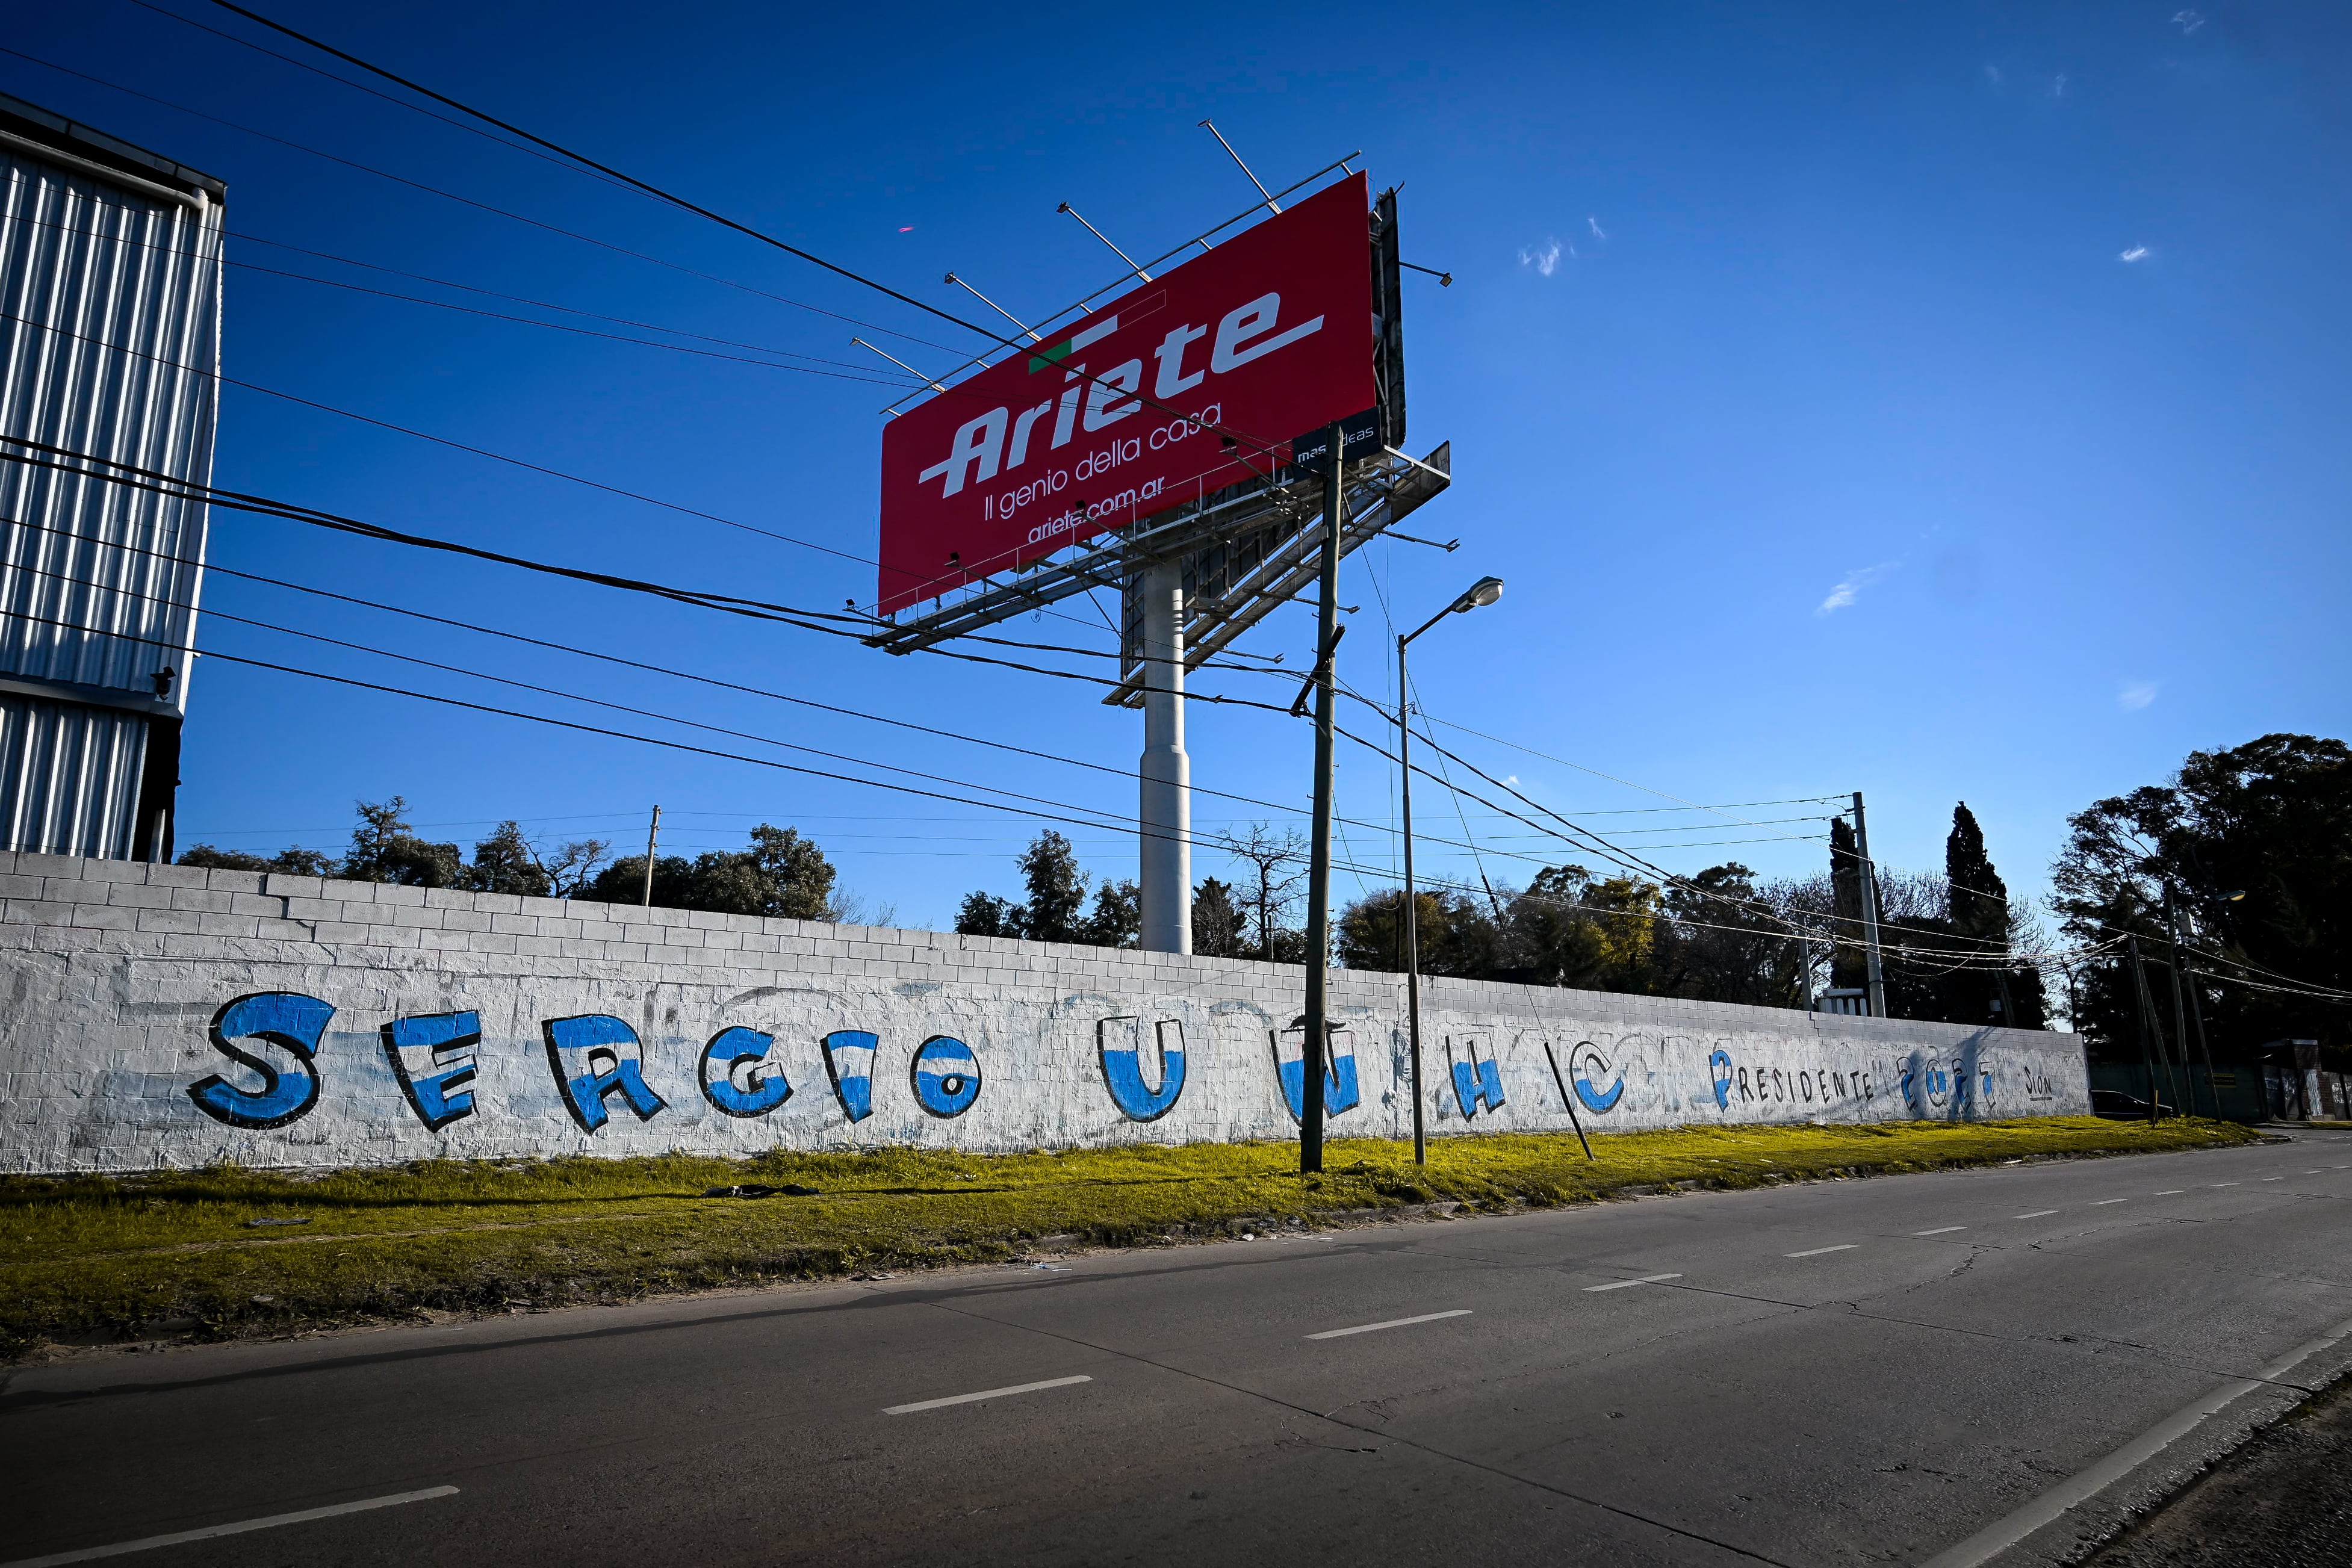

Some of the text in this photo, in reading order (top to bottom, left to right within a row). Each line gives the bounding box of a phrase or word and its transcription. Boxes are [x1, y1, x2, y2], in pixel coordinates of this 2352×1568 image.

[918, 292, 1324, 498] Ariete
[1341, 427, 1374, 447] deas
[999, 469, 1068, 519] genio
[1076, 437, 1141, 480] della
[1150, 403, 1221, 450] casa
[1028, 476, 1165, 544] ariete.com.ar
[185, 991, 982, 1136] SERGIO
[1708, 1050, 1874, 1113] PRESIDENTE
[1896, 1056, 1996, 1112] 2027
